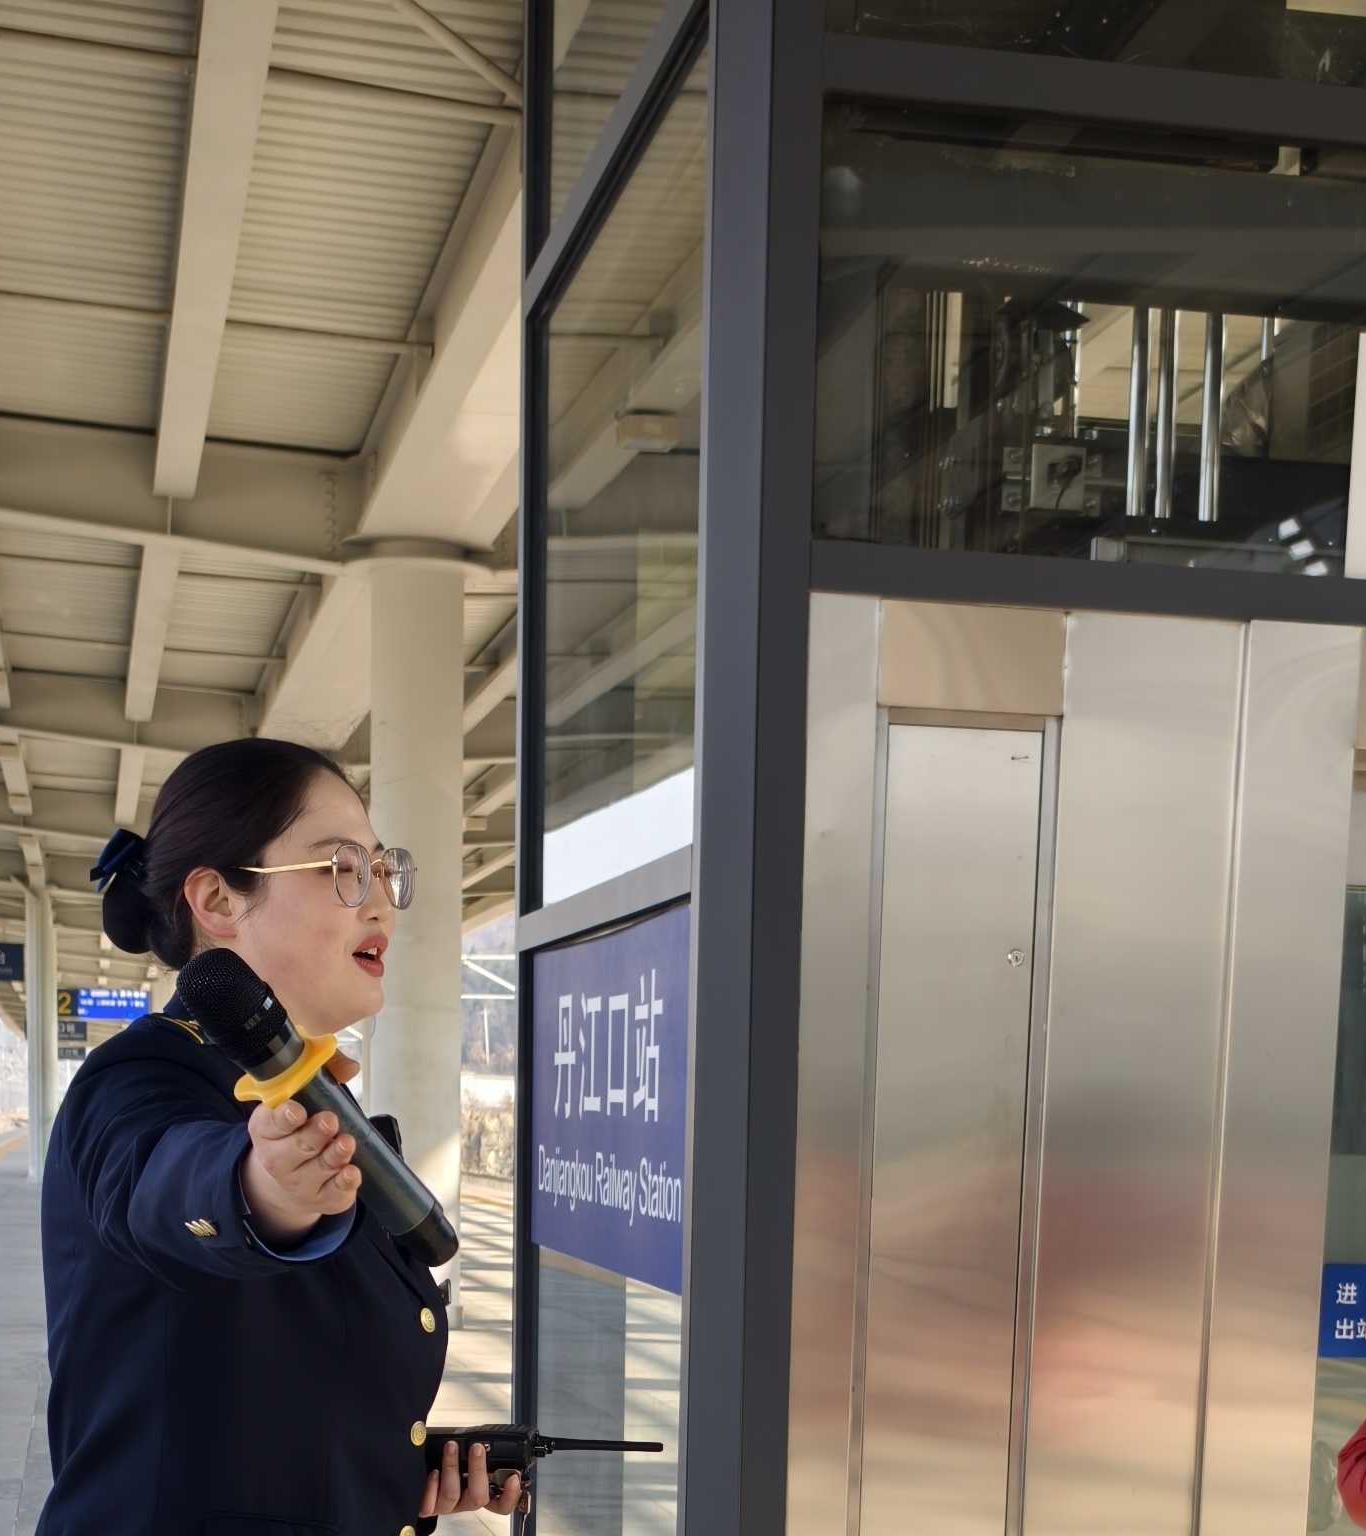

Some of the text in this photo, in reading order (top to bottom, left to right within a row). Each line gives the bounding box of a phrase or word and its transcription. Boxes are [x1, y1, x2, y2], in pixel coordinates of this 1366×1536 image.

[58, 992, 72, 1015] 2
[553, 968, 664, 1123] 丹江口站
[537, 1145, 682, 1227] Danjiangkou Railway Station
